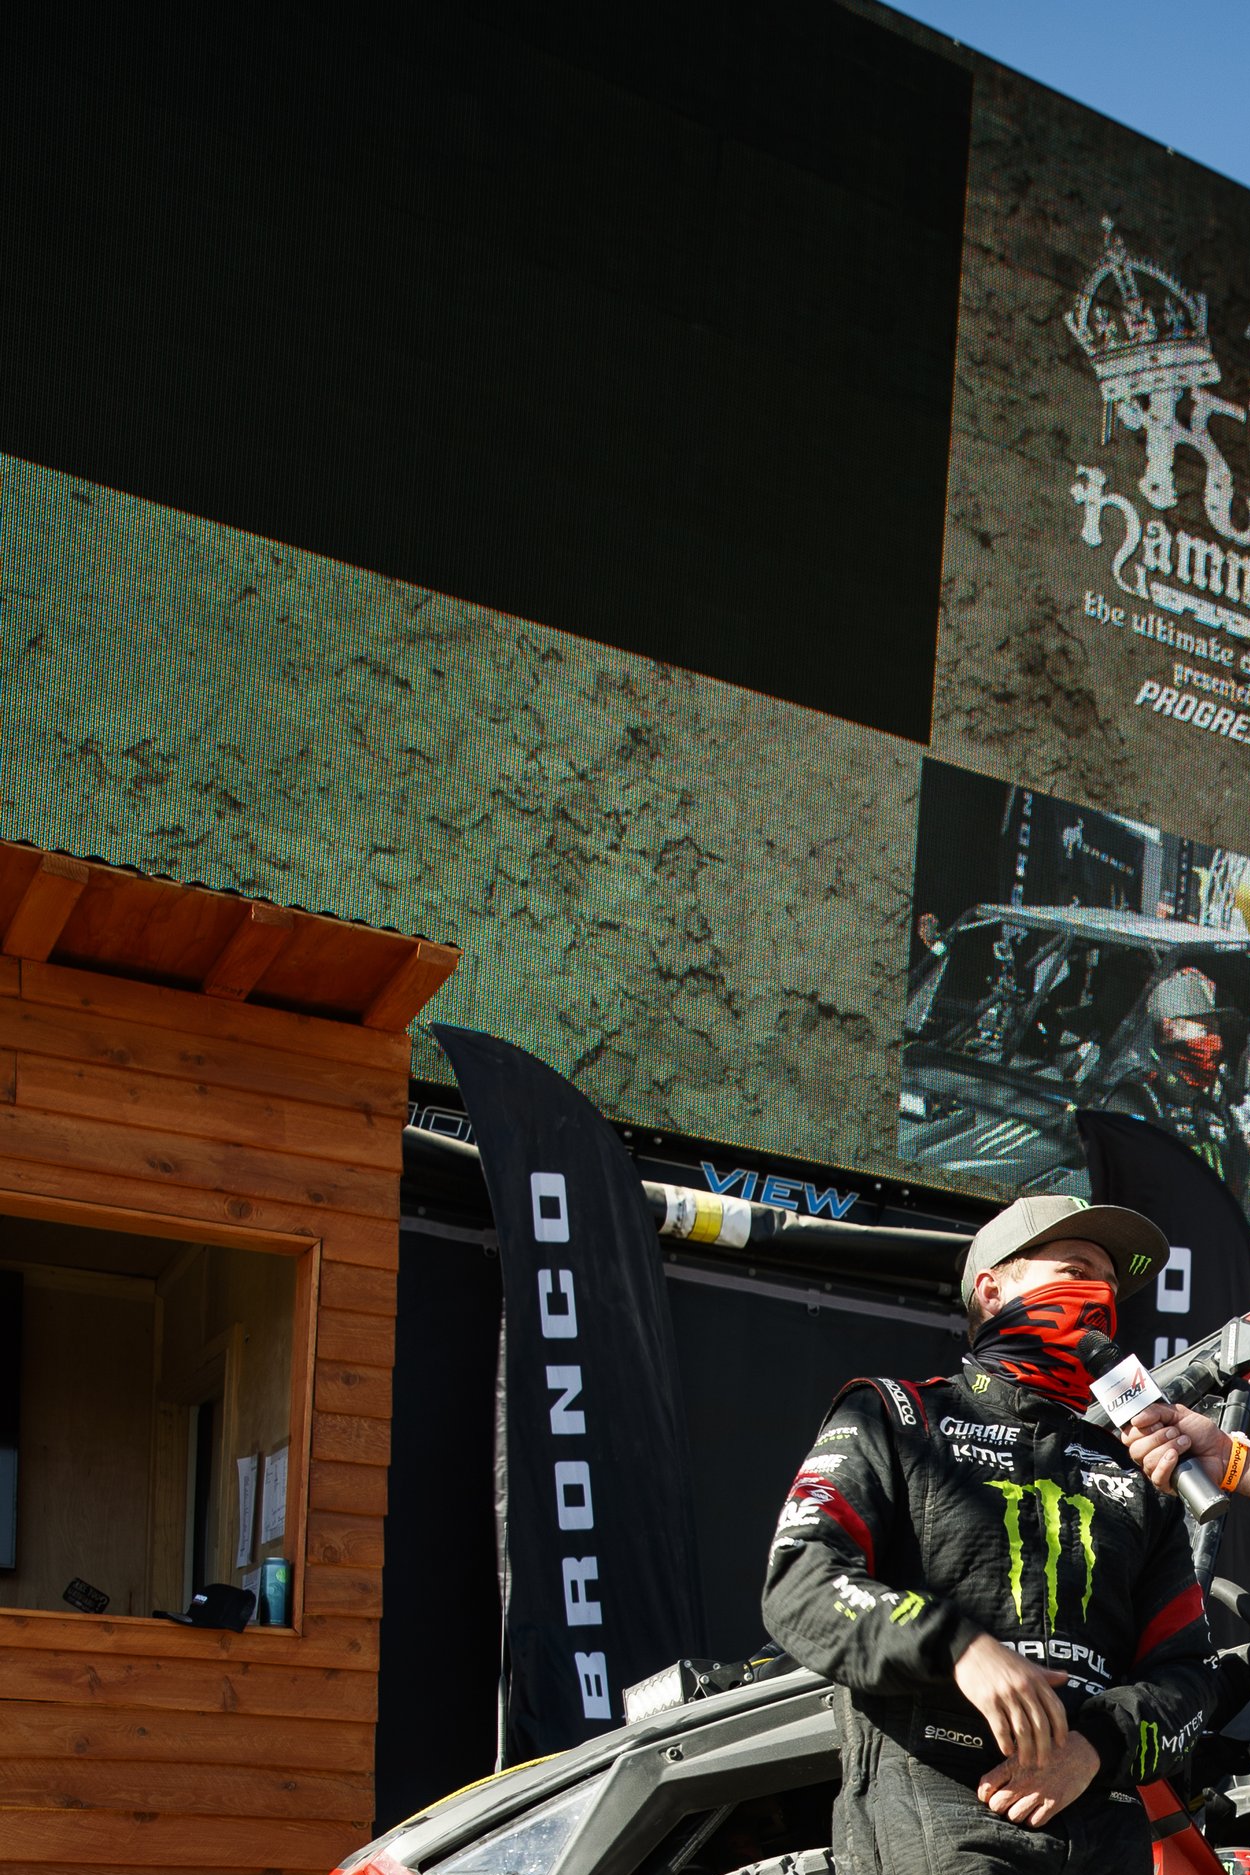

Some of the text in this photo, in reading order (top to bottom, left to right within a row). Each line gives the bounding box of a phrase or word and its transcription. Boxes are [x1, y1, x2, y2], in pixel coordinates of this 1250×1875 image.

[1084, 590, 1125, 627] the
[1132, 613, 1234, 668] ultimate
[701, 1162, 860, 1219] VIEW
[530, 1172, 612, 1720] BRONCO
[939, 1416, 1021, 1443] CURRIE
[951, 1444, 1014, 1467] KMC
[1225, 1443, 1248, 1486] Production
[1080, 1469, 1135, 1507] FOX
[924, 1724, 984, 1750] sparco
